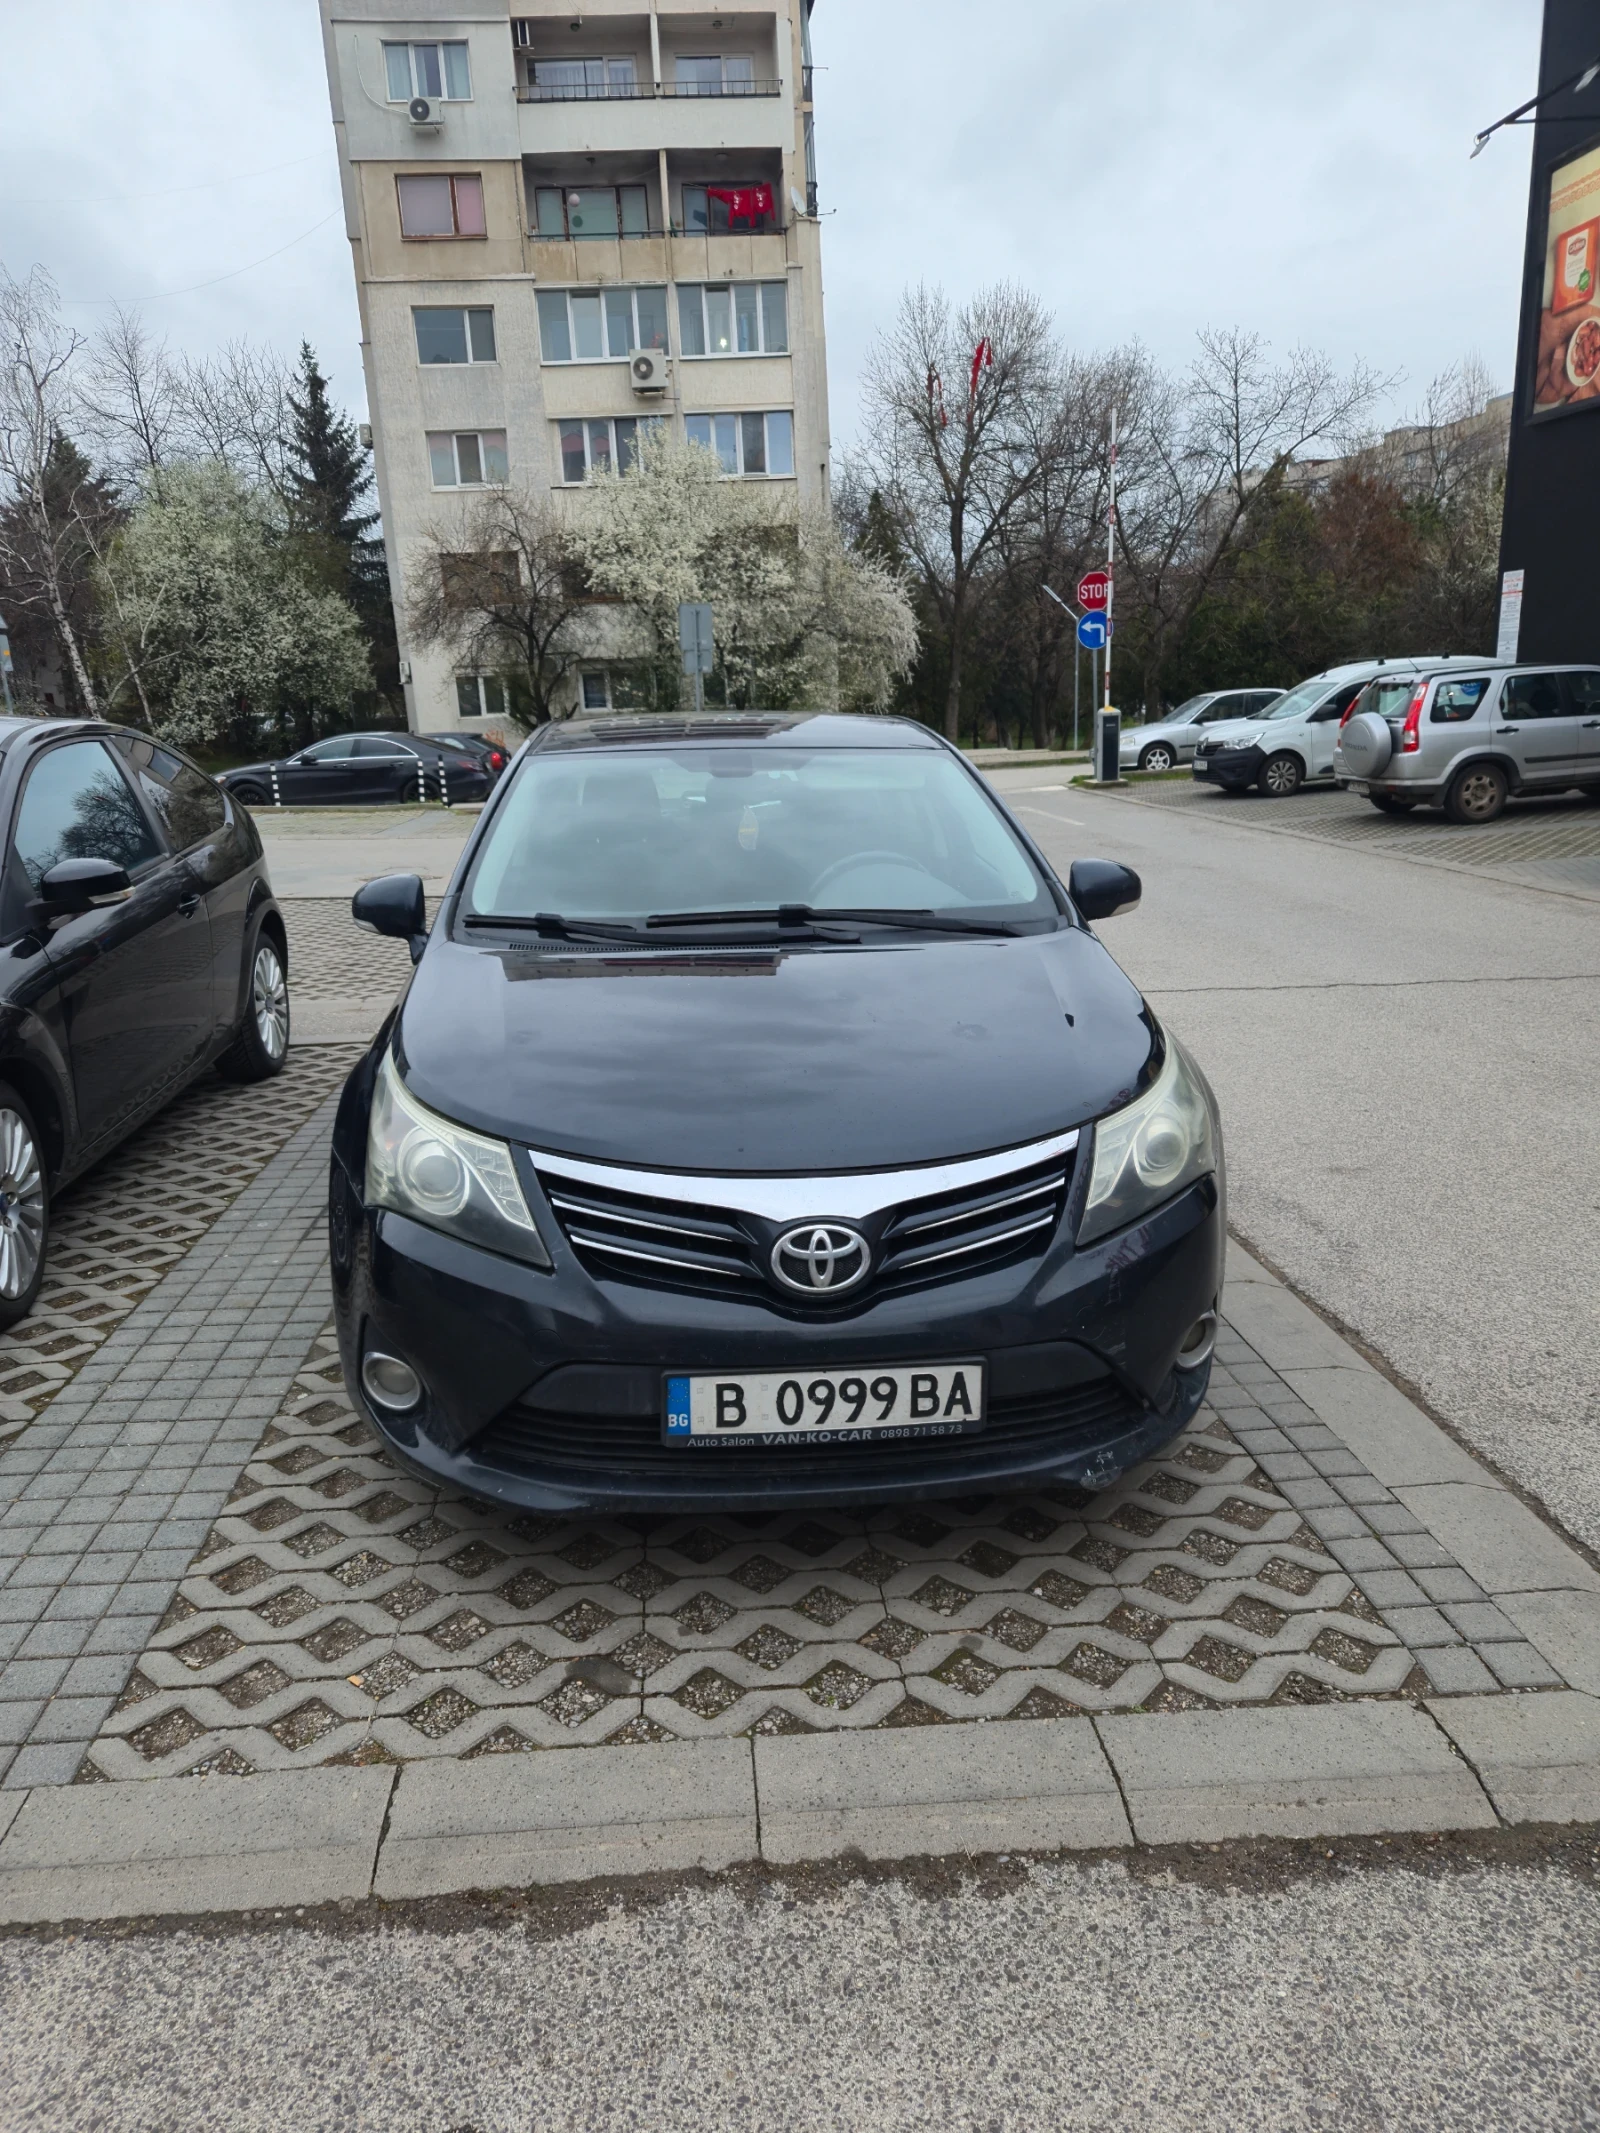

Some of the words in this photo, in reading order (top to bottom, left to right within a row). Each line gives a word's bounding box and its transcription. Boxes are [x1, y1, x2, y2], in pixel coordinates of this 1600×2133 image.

[715, 1382, 747, 1428] B
[776, 1376, 898, 1426] 0999
[910, 1371, 973, 1418] BA
[668, 1413, 689, 1427] BG
[687, 1438, 718, 1447] Auto
[721, 1436, 755, 1447] Salon
[762, 1429, 872, 1445] VAN-KO-CAR
[880, 1428, 910, 1438] 0898
[914, 1427, 927, 1436] 71
[949, 1424, 963, 1433] 73
